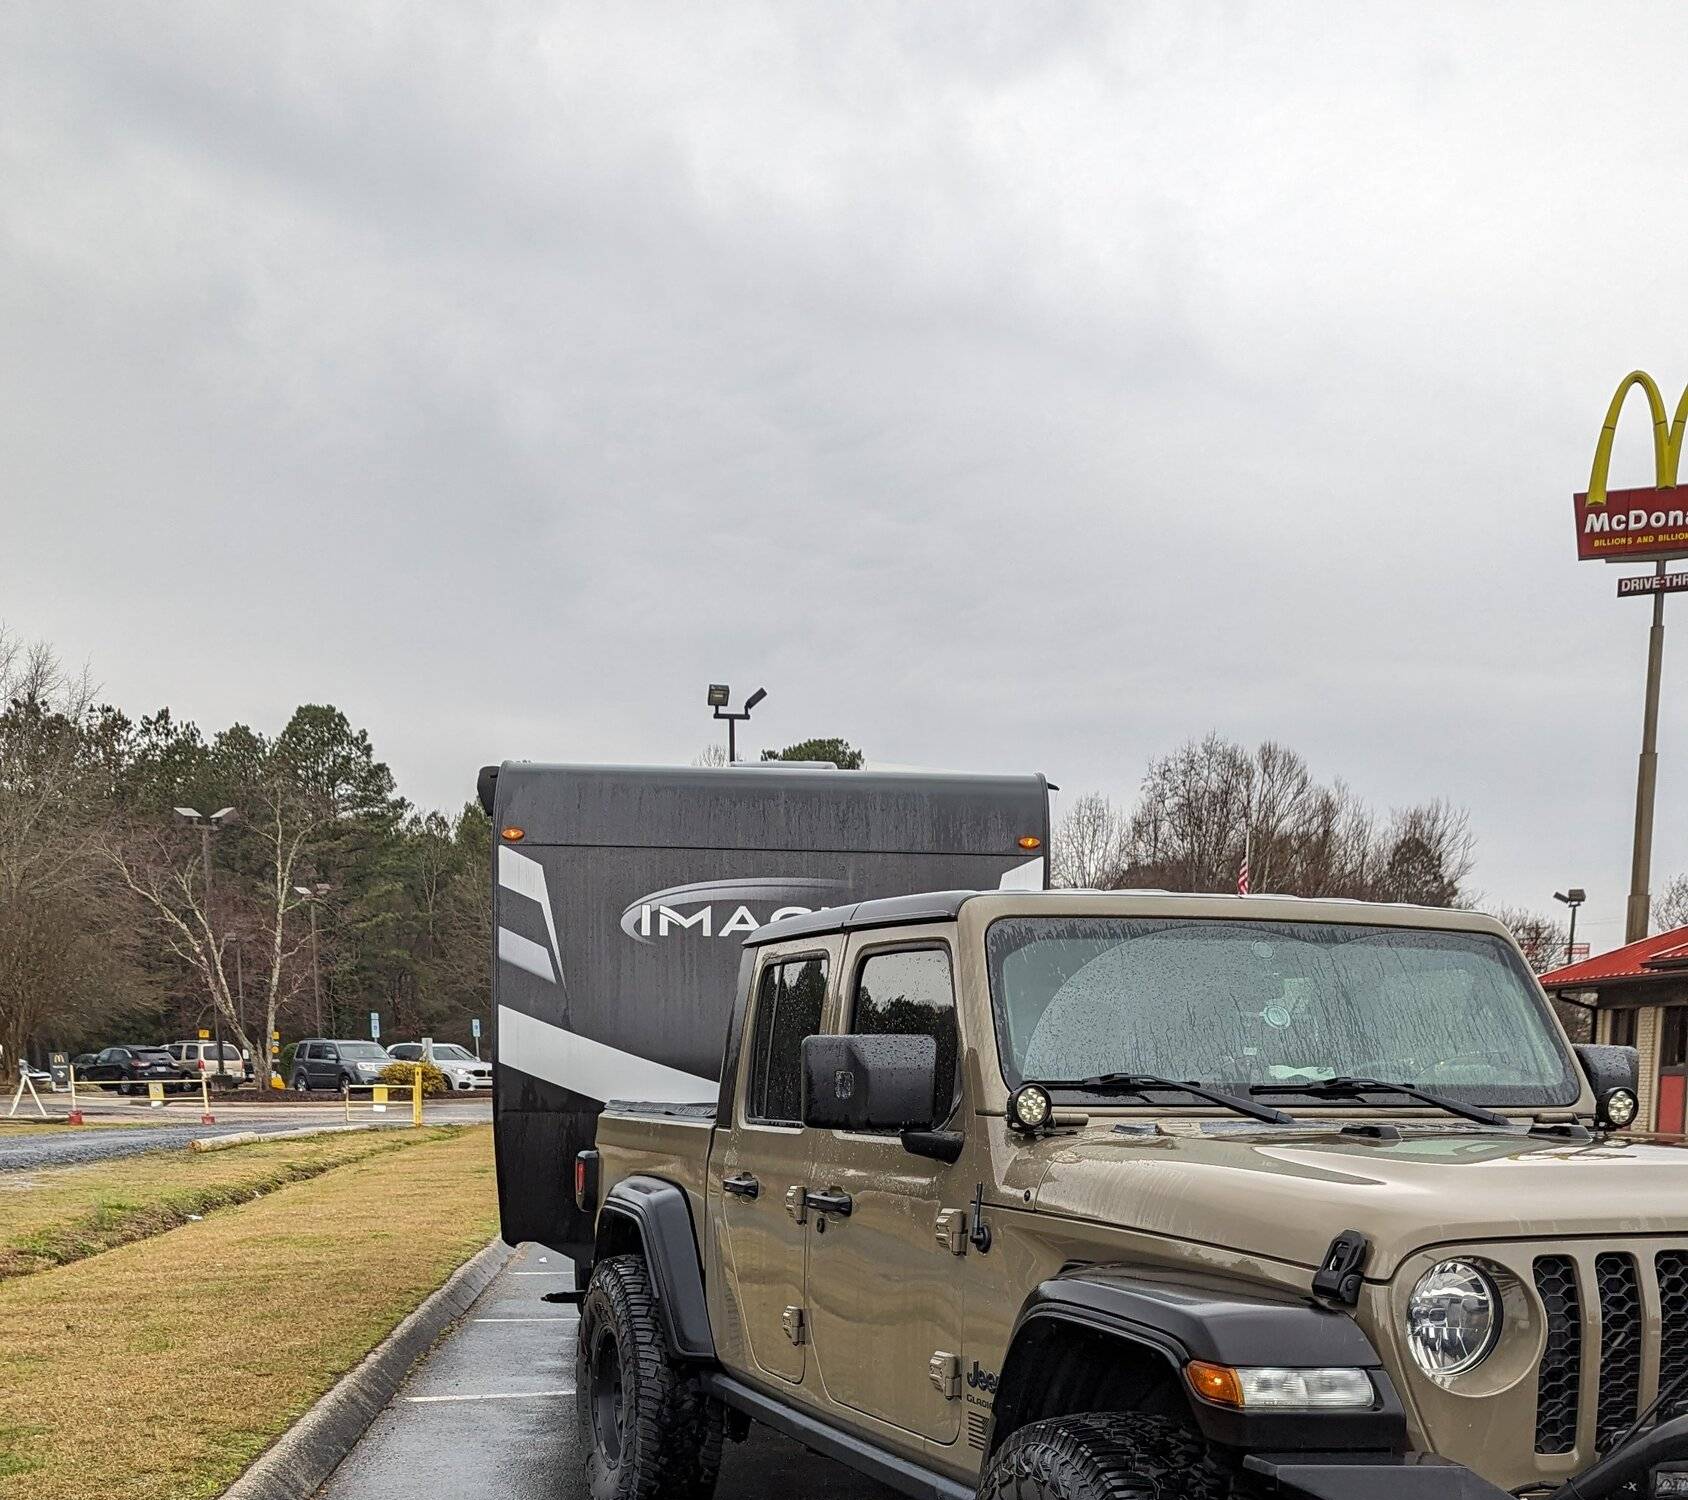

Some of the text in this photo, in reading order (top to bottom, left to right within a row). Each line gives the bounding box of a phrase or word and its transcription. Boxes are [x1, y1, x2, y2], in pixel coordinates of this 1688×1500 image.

[1584, 509, 1688, 533] McDon
[1594, 537, 1633, 547] BILLIONS
[1636, 535, 1654, 543] AND
[641, 904, 831, 937] IMA
